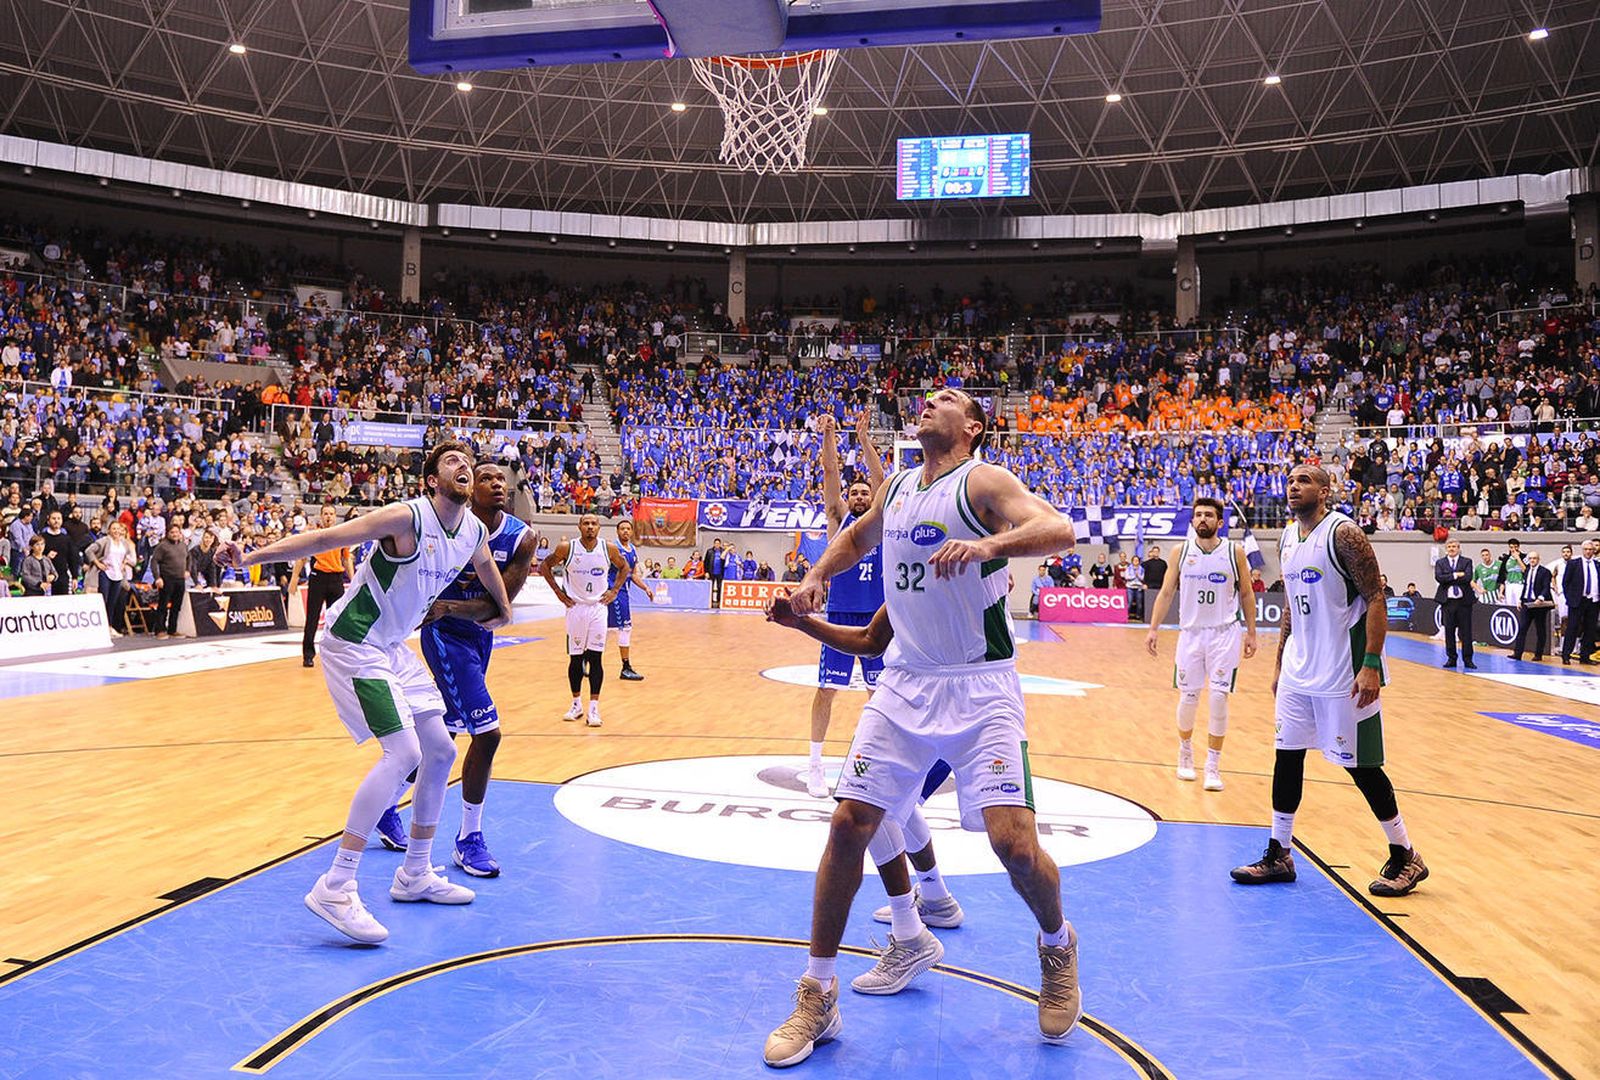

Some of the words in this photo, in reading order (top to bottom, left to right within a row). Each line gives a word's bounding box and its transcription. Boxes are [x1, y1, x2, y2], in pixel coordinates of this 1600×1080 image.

[1580, 245, 1594, 260] D
[406, 263, 417, 276] B
[731, 282, 743, 295] C
[1180, 277, 1193, 292] C
[913, 527, 938, 542] plus
[895, 562, 926, 592] 32
[1209, 573, 1225, 582] plus
[1302, 569, 1317, 580] plus
[586, 581, 593, 593] 4
[1043, 590, 1125, 610] endesa
[1197, 590, 1215, 604] 30
[1294, 594, 1311, 615] 15
[1495, 616, 1514, 637] KIA
[1002, 783, 1017, 791] plus
